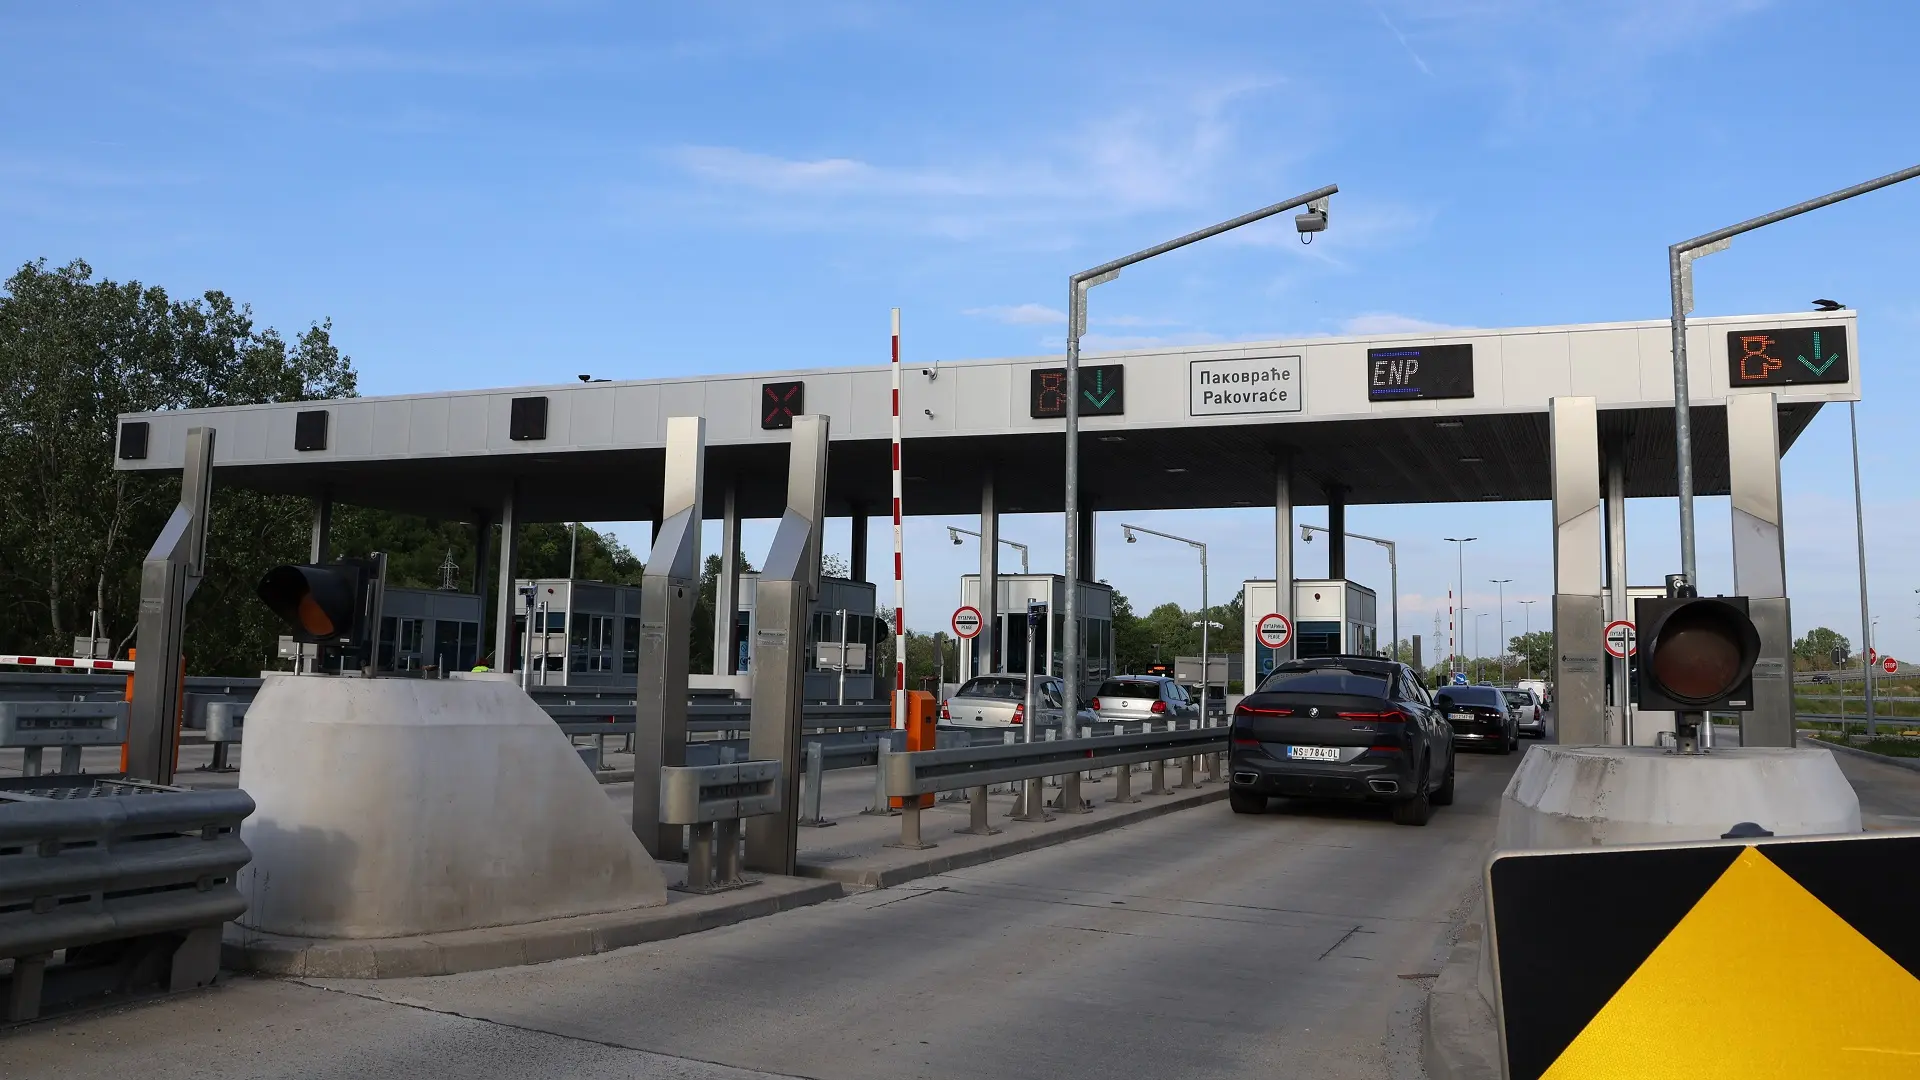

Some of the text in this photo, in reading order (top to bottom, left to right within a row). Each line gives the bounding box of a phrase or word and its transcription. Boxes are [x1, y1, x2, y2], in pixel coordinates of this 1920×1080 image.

[1200, 368, 1291, 385] Паковраће
[1373, 359, 1419, 386] ENP
[1203, 388, 1288, 405] Pakovraće
[1293, 747, 1304, 756] NS
